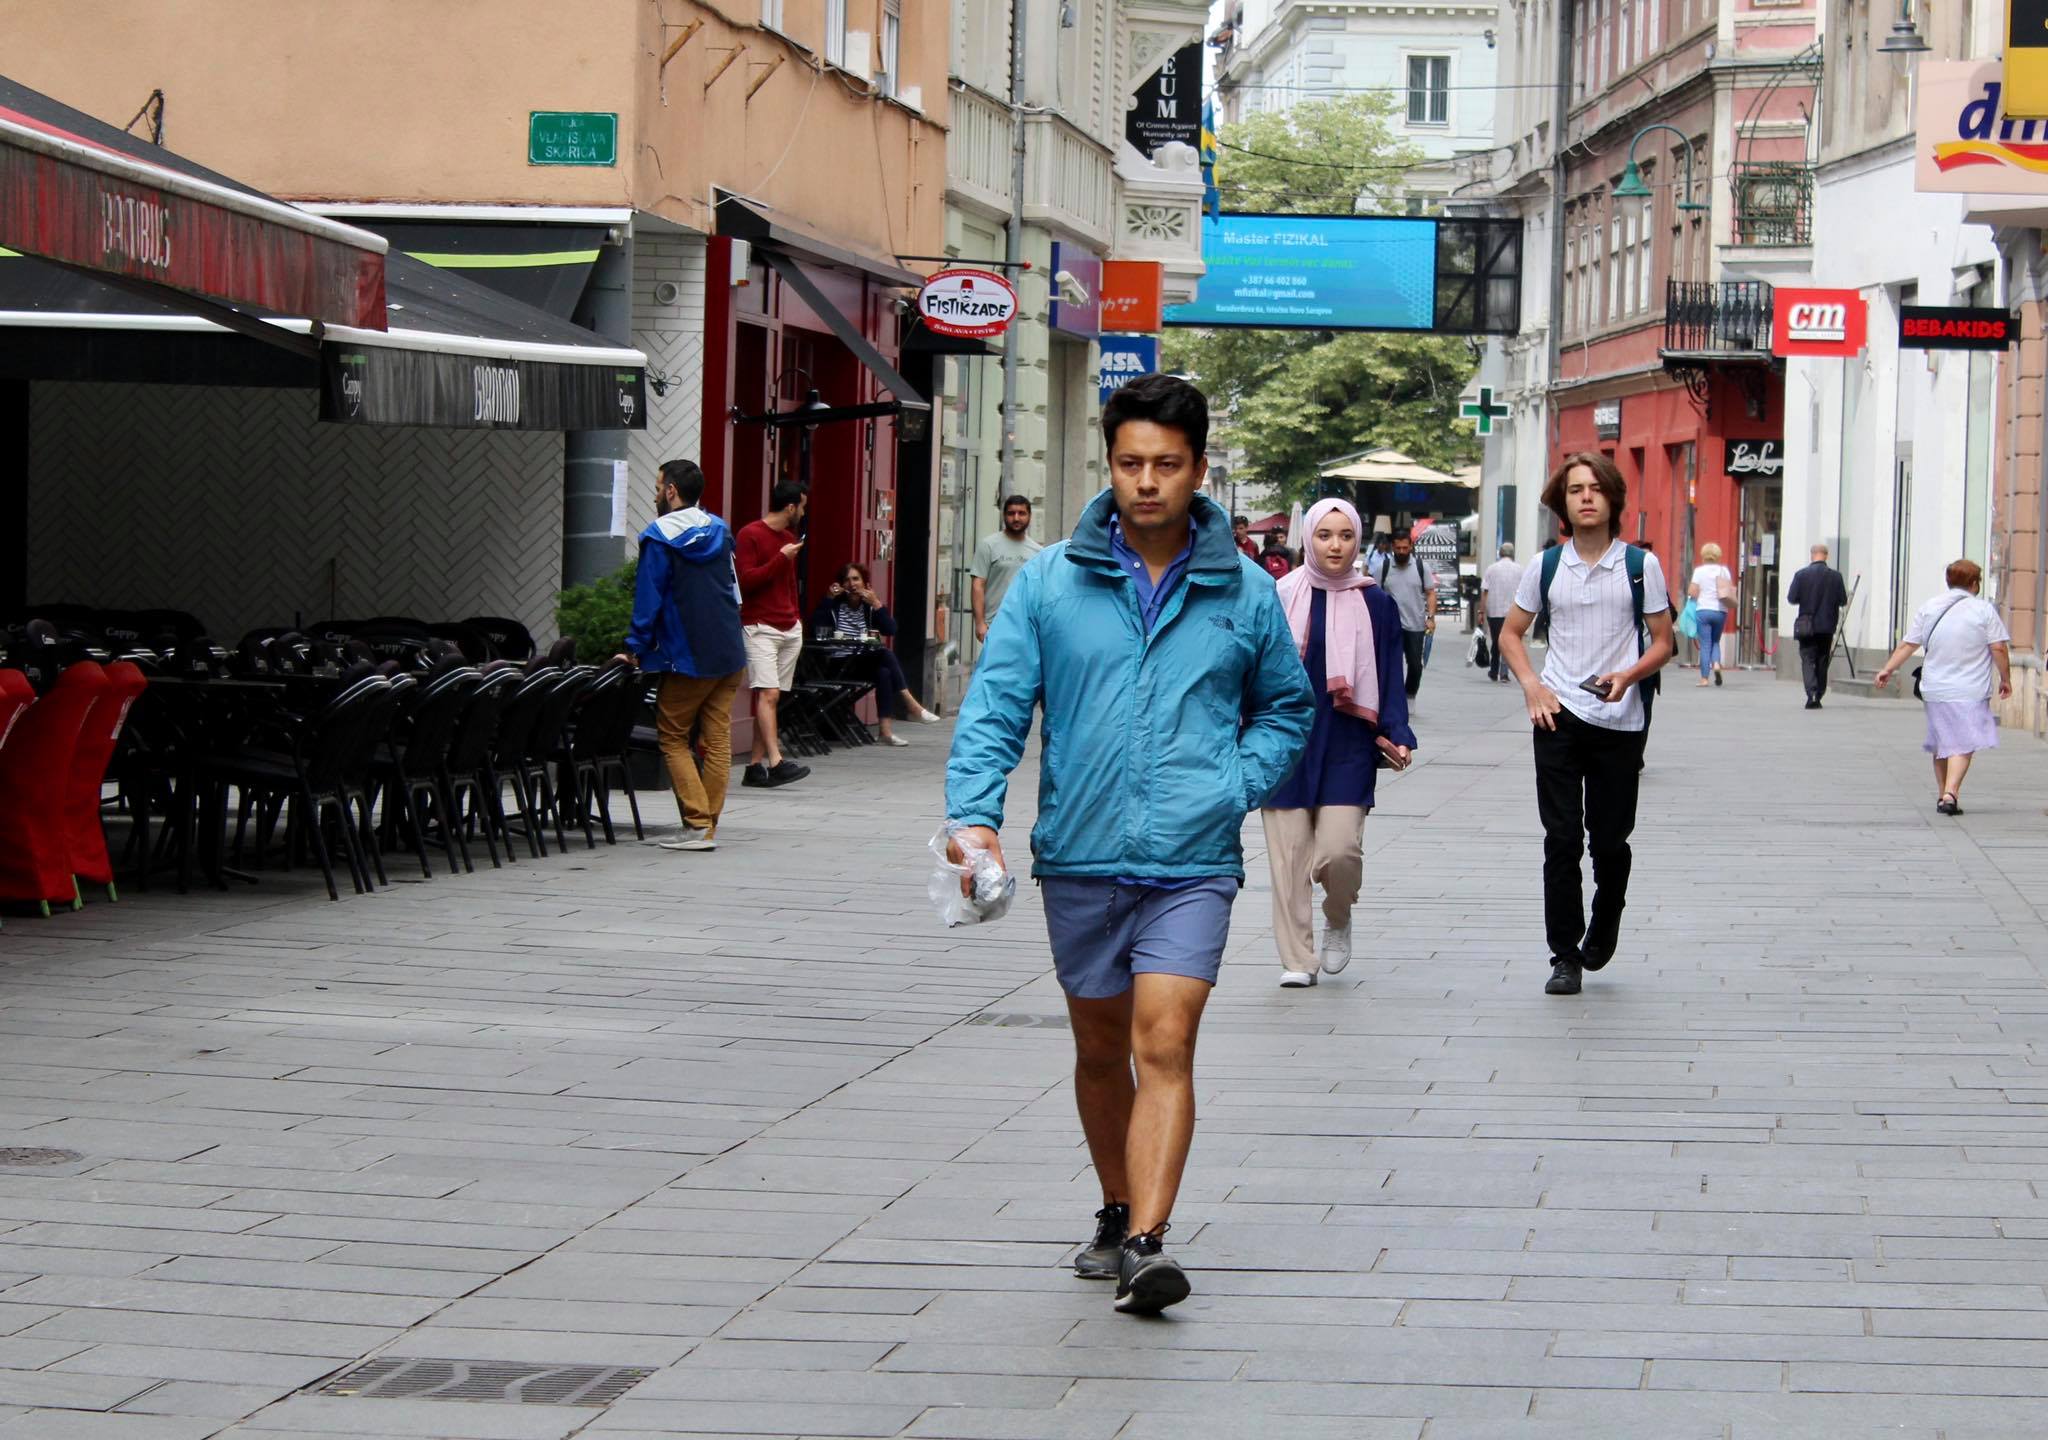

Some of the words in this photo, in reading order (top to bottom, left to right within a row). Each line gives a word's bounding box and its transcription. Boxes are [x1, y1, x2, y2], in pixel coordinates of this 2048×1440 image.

[1224, 231, 1269, 245] Master
[1273, 234, 1329, 247] FIZIKAL
[926, 294, 1008, 318] FISTIKZADE
[1788, 304, 1846, 330] cm
[1903, 319, 2006, 338] BEBAKIDS
[1100, 352, 1145, 372] ASA
[1415, 545, 1457, 553] SREBRENICA
